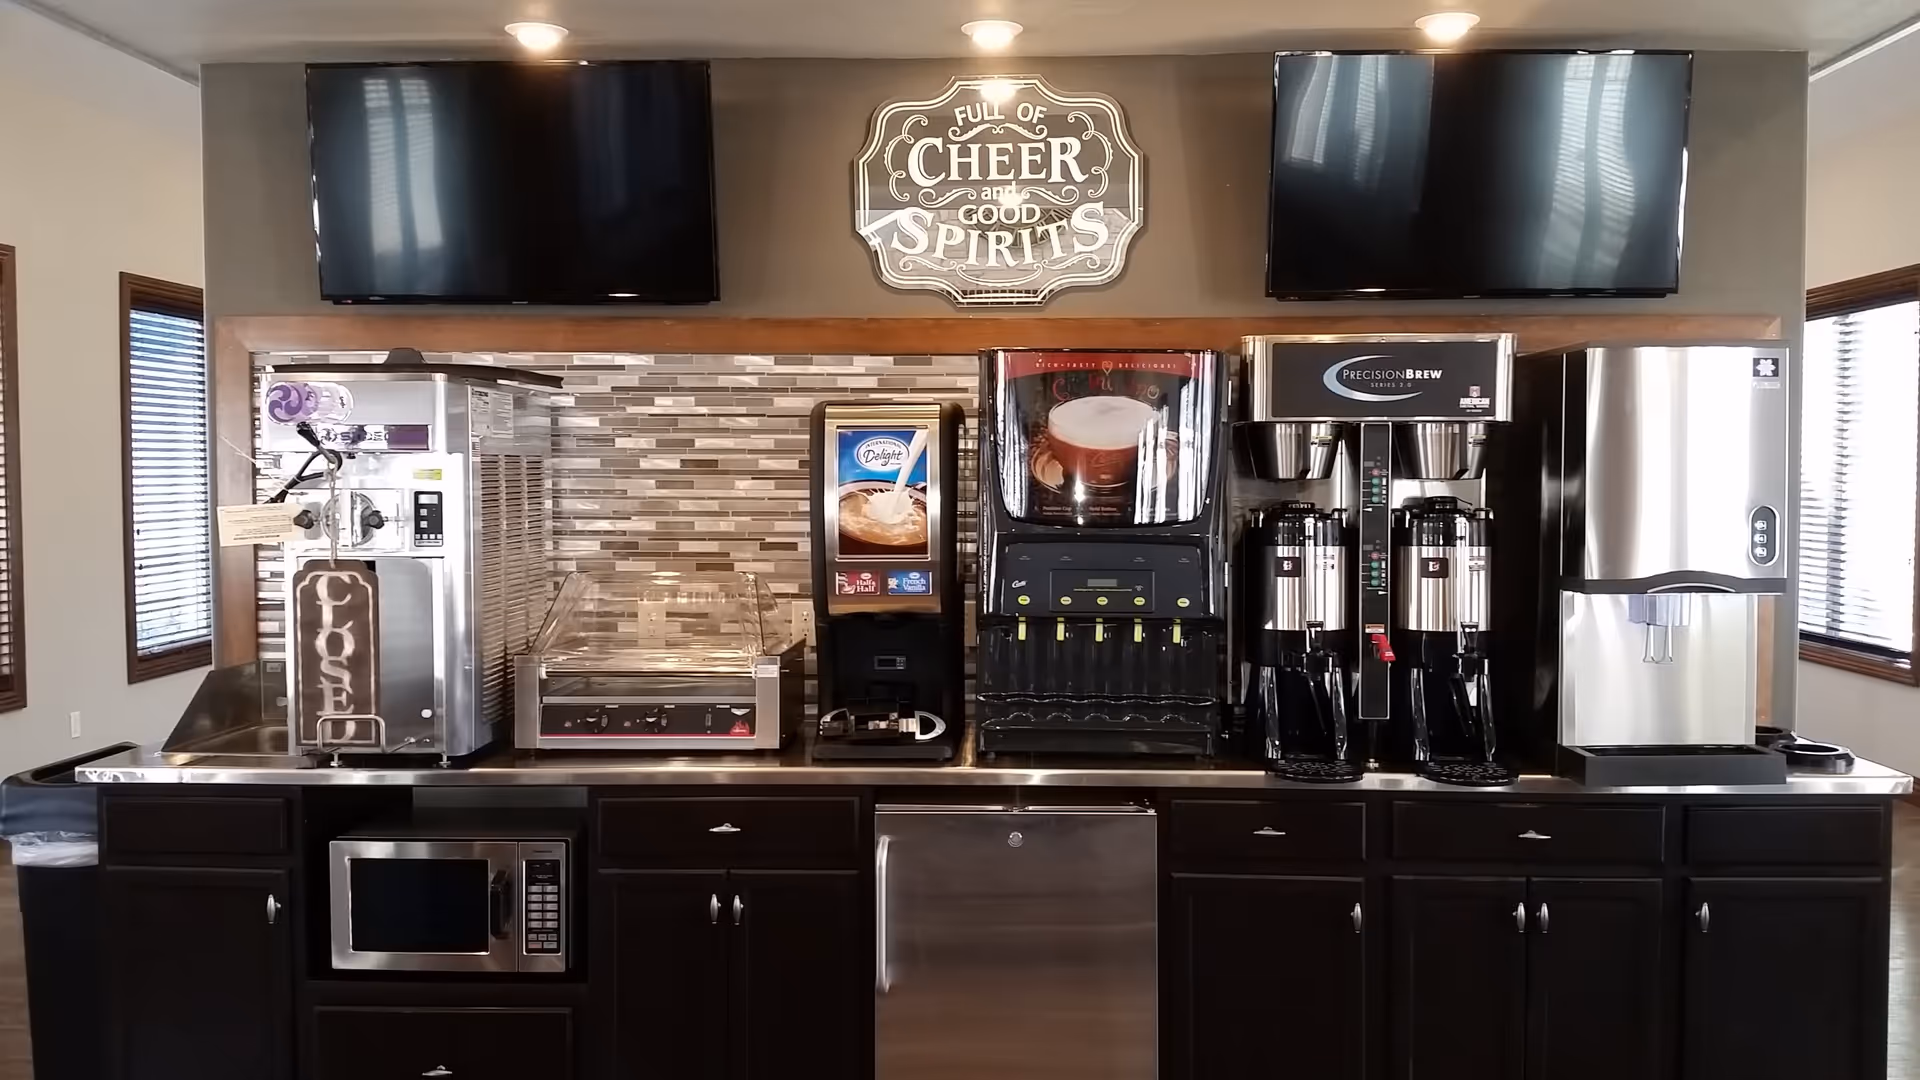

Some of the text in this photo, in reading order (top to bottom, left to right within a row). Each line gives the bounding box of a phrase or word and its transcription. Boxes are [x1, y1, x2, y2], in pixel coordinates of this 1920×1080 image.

[954, 101, 1048, 127] FULL OF
[907, 136, 1089, 187] CHEER
[981, 181, 1017, 201] and
[957, 203, 1042, 225] GOOD
[890, 201, 1109, 268] SPIRITS
[863, 448, 903, 466] Delight
[902, 577, 926, 585] French
[314, 574, 356, 742] CLOSED
